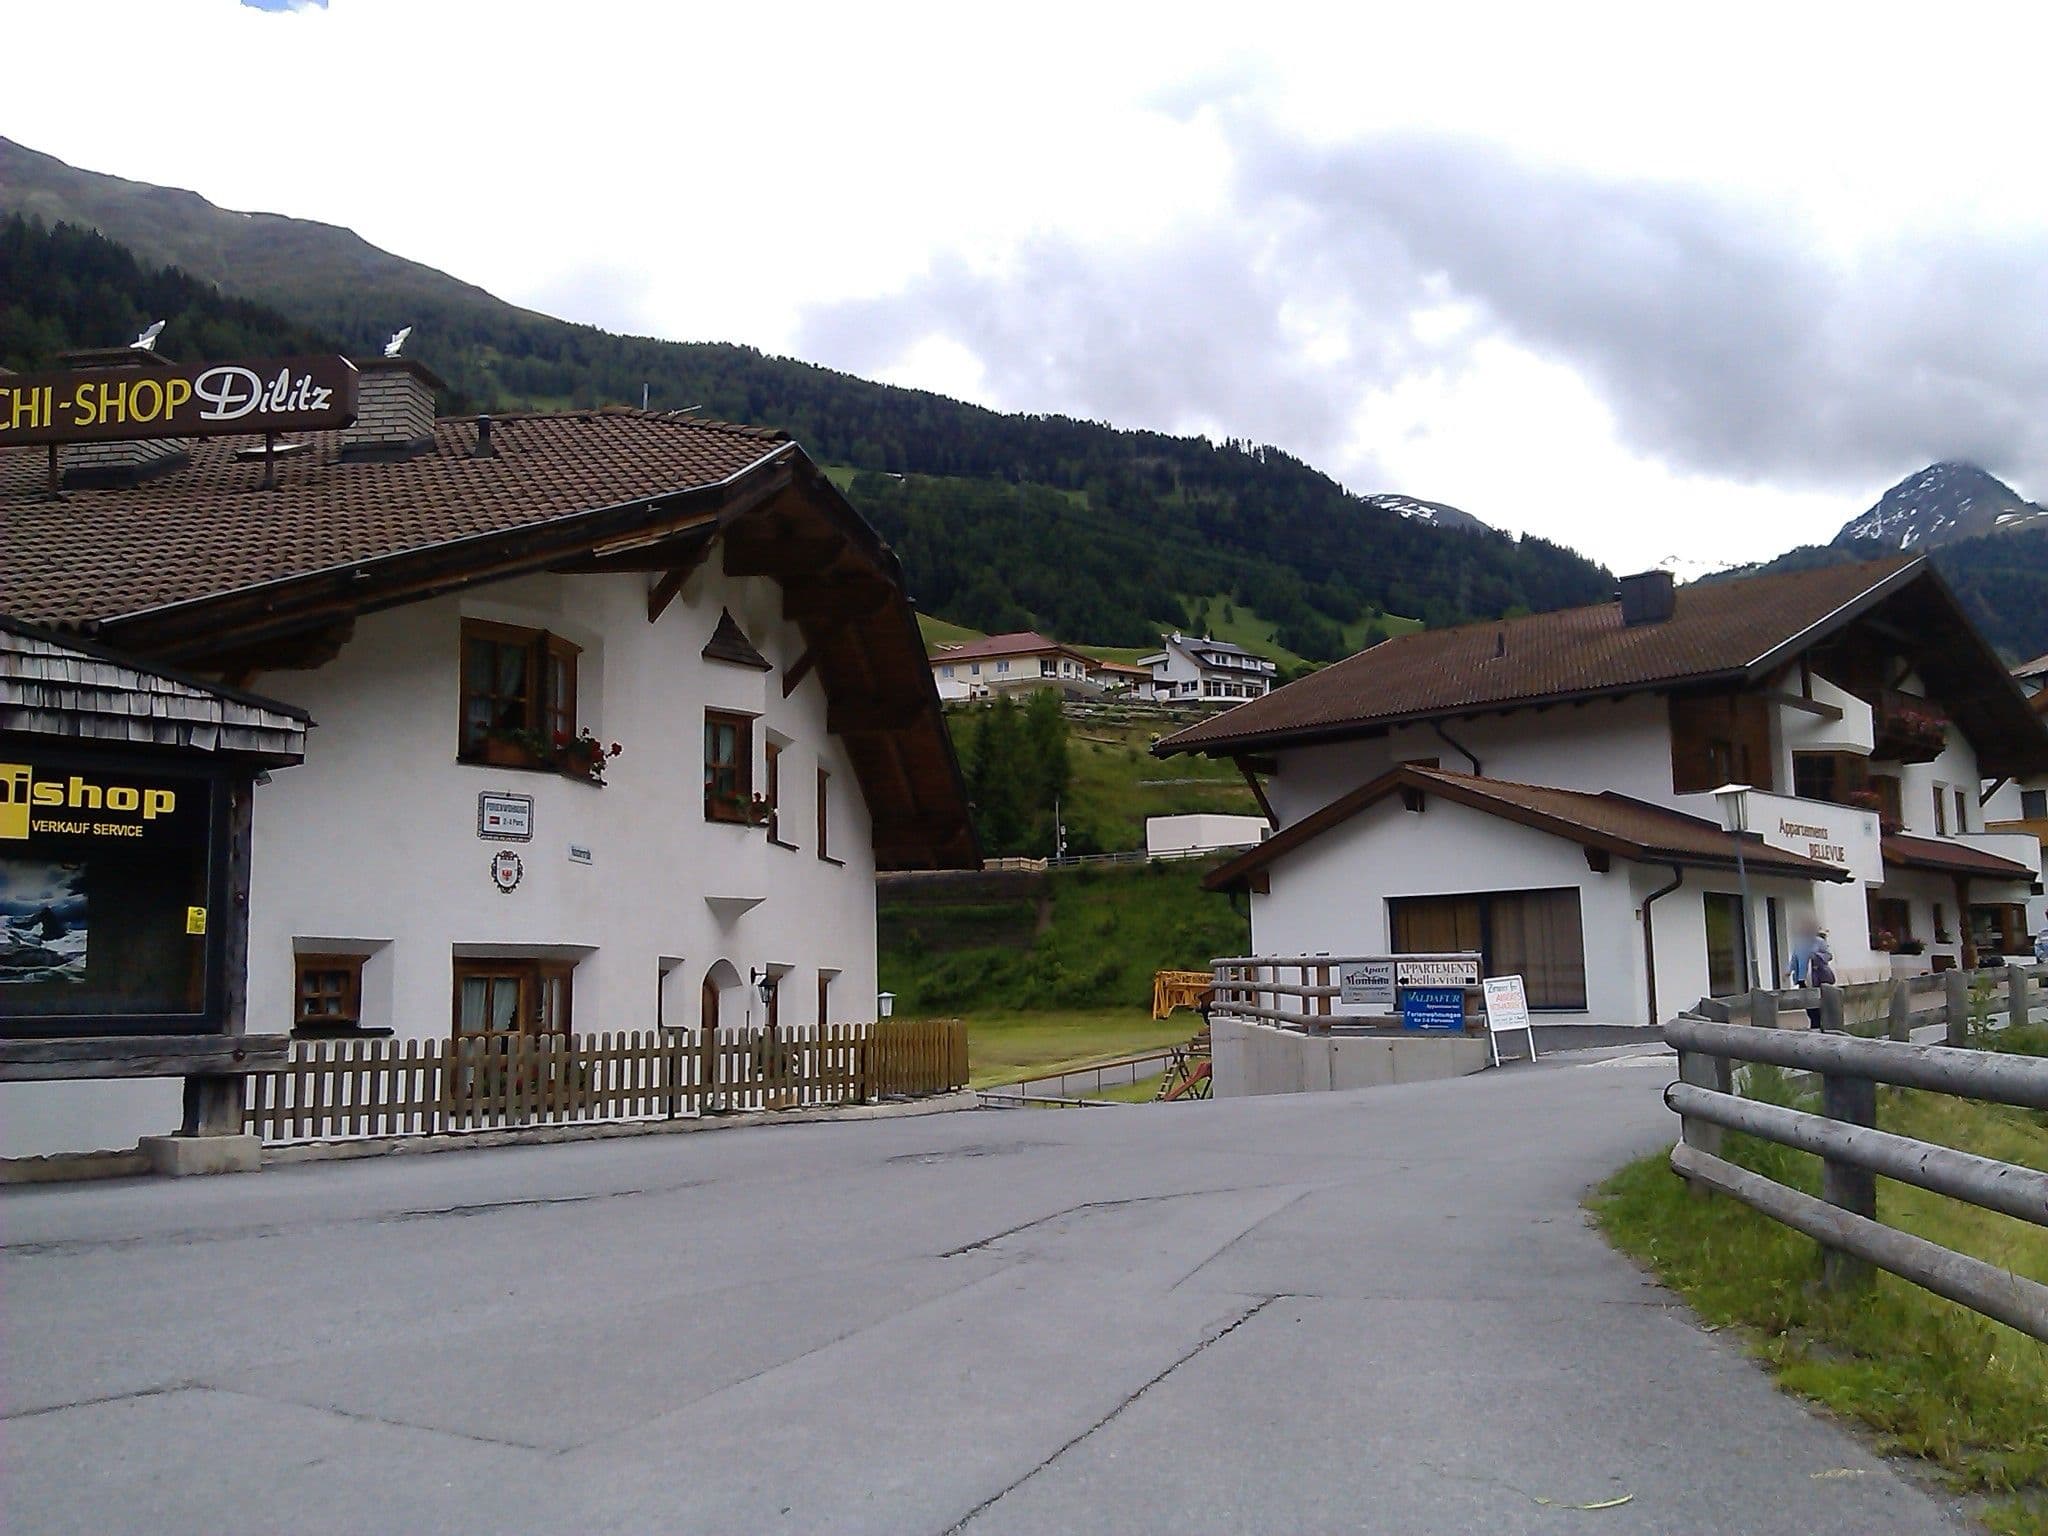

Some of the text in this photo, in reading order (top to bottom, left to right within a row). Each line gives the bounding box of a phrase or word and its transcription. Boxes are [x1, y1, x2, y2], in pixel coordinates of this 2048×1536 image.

[194, 366, 333, 421] Dilitz
[32, 819, 144, 837] VERKAUF SERVICE
[1808, 843, 1845, 862] BELLEVUE
[1364, 966, 1389, 975] Apart
[1400, 963, 1476, 974] APPARTEMENTS
[1409, 975, 1465, 985] bella-vista
